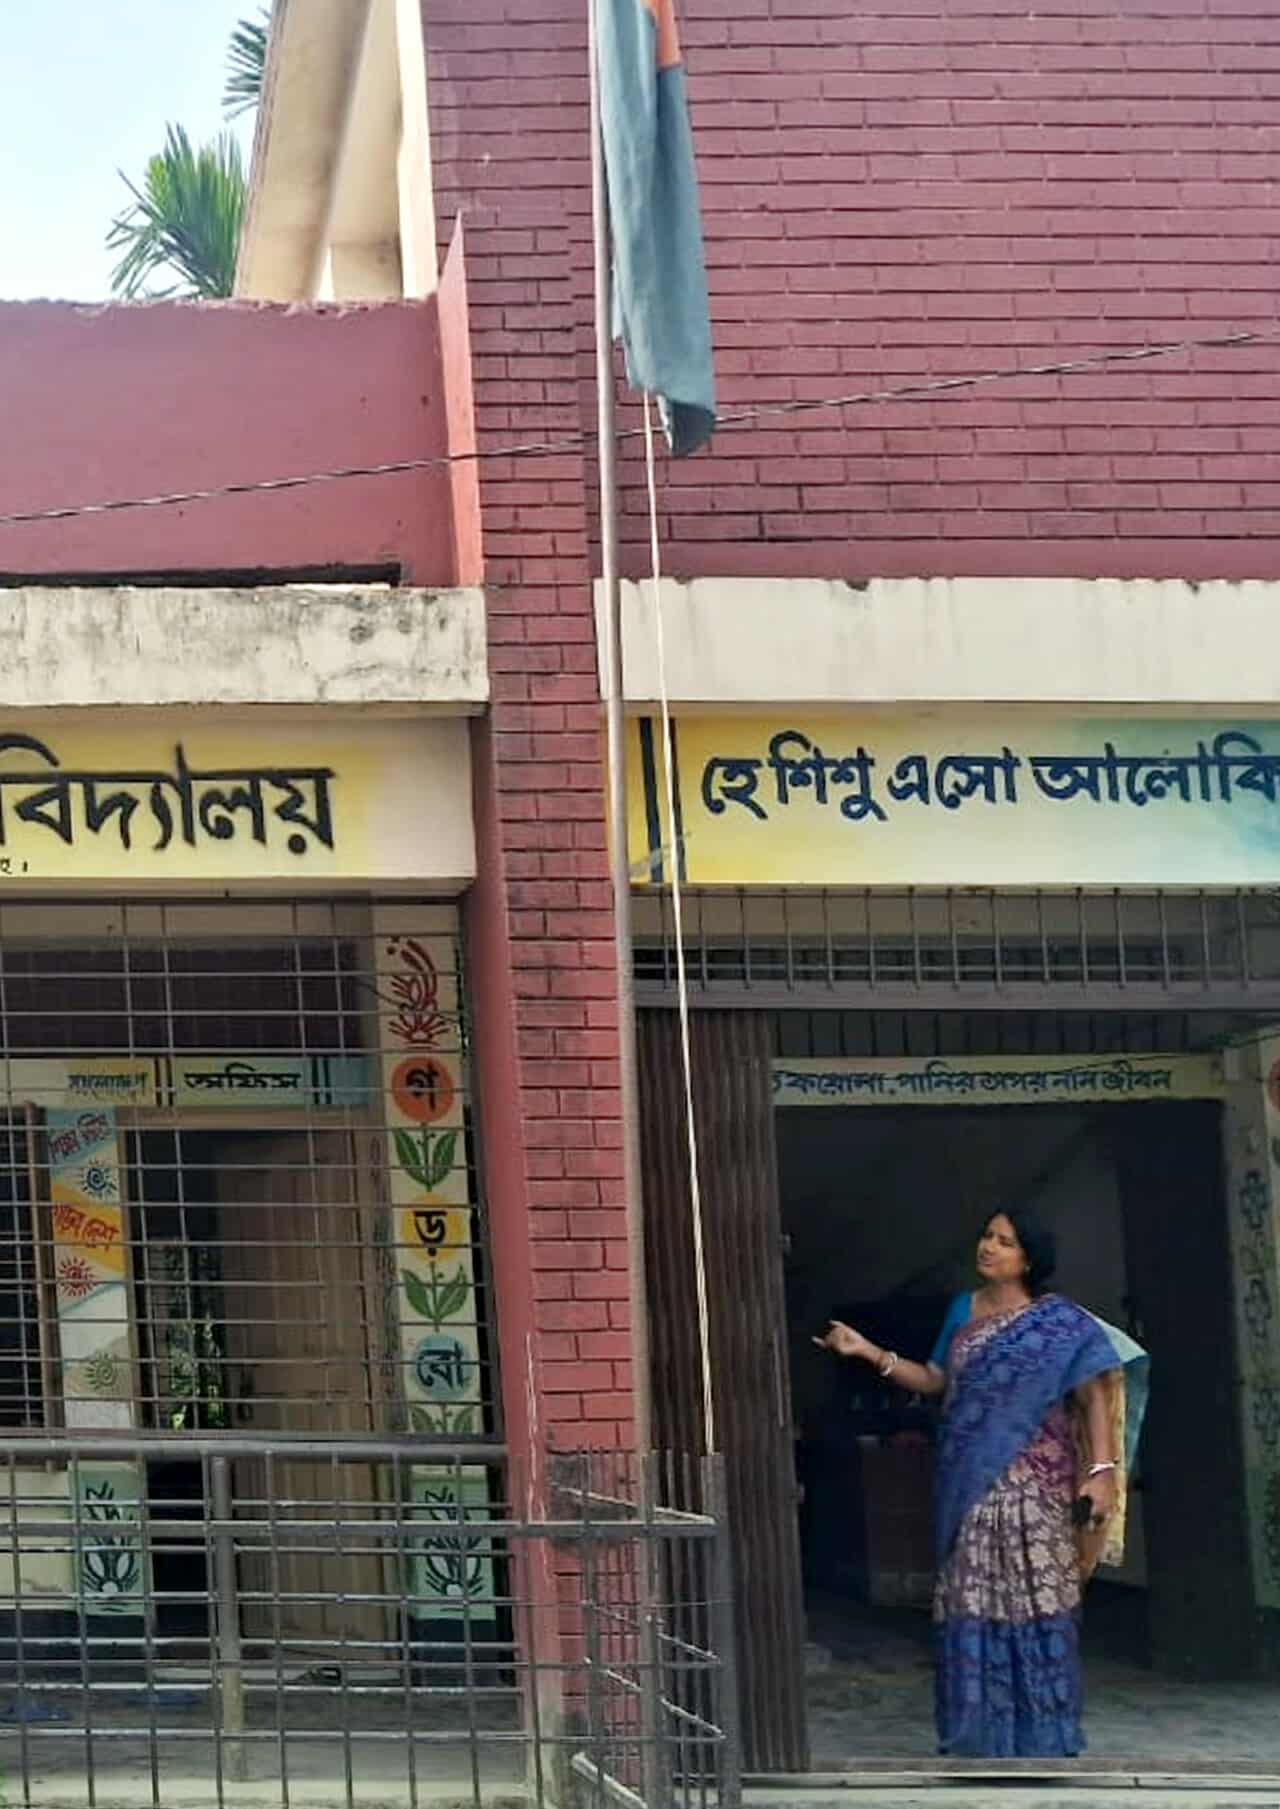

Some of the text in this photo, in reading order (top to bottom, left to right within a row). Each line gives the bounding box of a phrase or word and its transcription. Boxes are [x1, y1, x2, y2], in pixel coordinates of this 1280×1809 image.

[700, 754, 768, 820] হে
[767, 730, 889, 823] শিশু
[886, 746, 1022, 806] এসো
